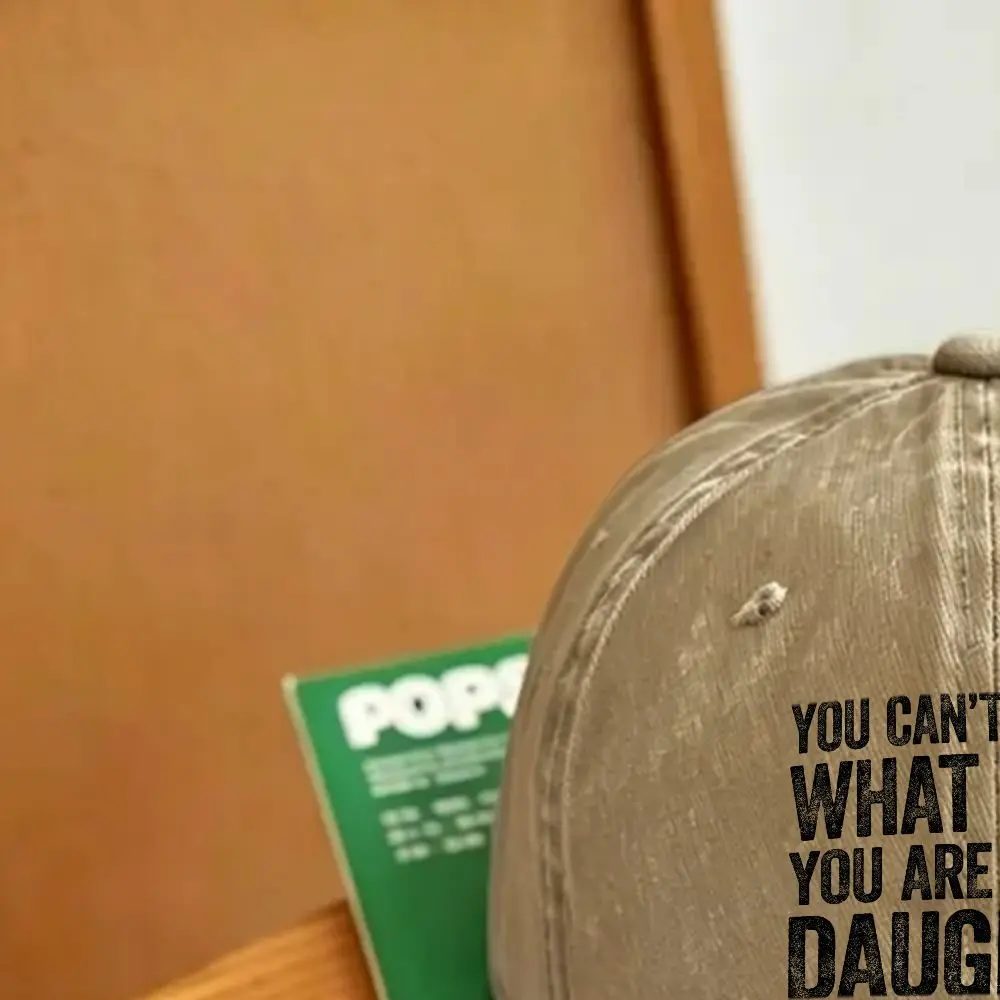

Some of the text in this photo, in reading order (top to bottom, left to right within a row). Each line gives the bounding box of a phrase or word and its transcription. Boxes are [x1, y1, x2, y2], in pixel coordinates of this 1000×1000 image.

[791, 697, 870, 754] YOU
[789, 753, 979, 841] WHAT
[788, 846, 883, 906] YOU
[900, 842, 993, 901] ARE
